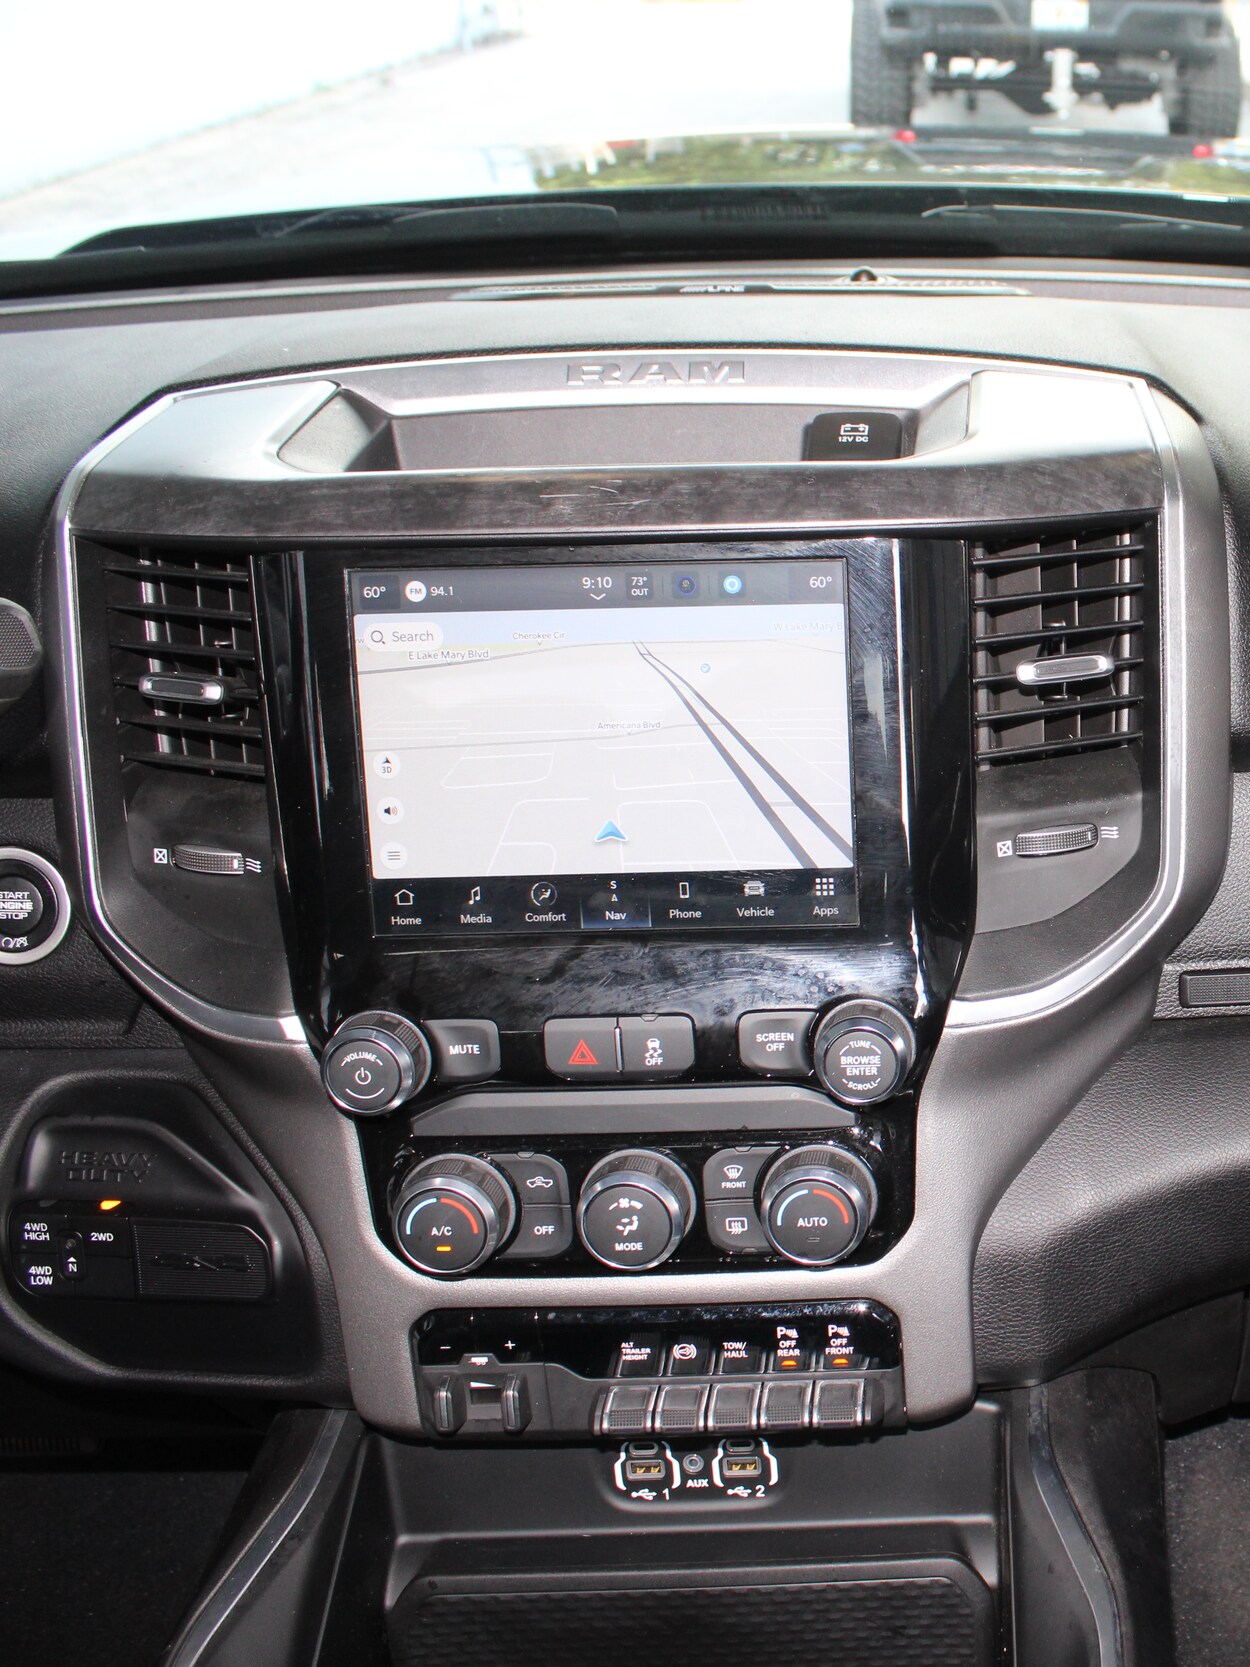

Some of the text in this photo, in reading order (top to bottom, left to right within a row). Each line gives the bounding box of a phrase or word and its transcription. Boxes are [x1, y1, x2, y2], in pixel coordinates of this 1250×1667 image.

[566, 360, 746, 386] RAM
[582, 576, 612, 589] 9:10
[809, 576, 832, 588] 60°
[363, 586, 386, 598] 60°
[410, 586, 454, 597] FM 94.1
[631, 588, 648, 596] OUT
[392, 630, 434, 643] Search
[512, 632, 551, 640] Cherokee
[408, 649, 490, 662] E Lake Mary Blvd
[598, 720, 660, 730] Americana Blvd
[381, 766, 392, 774] 3D
[605, 910, 627, 920] Nav
[669, 908, 702, 918] Phone
[736, 906, 775, 917] Vehicle
[812, 906, 839, 917] Apps
[391, 916, 422, 926] Home
[460, 914, 492, 924] Media
[525, 912, 566, 922] Comfort
[756, 1032, 794, 1042] SCREEN
[448, 1044, 480, 1056] MUTE
[766, 1043, 785, 1052] OFF
[848, 1040, 872, 1050] TUNE
[344, 1051, 378, 1062] VOLUME
[645, 1056, 664, 1066] OFF
[840, 1055, 881, 1065] BROWSE
[846, 1066, 878, 1076] ENTER
[847, 1080, 878, 1091] SCROLL
[58, 1150, 155, 1167] HEAVY
[65, 1168, 150, 1184] DUTY
[721, 1180, 746, 1190] FRONT
[24, 1222, 48, 1232] 4WD
[797, 1217, 828, 1228] AUTO
[431, 1226, 452, 1237] A/C
[534, 1226, 555, 1235] OFF
[24, 1232, 50, 1241] HIGH
[90, 1232, 114, 1242] 2WD
[614, 1242, 643, 1252] MODE
[28, 1266, 52, 1275] 4WD
[68, 1264, 78, 1272] N
[30, 1276, 54, 1286] LOW
[722, 1342, 747, 1350] TOW/
[779, 1340, 797, 1348] OFF
[830, 1338, 848, 1346] OFF
[724, 1350, 748, 1358] HAUL
[777, 1348, 800, 1357] REAR
[825, 1346, 855, 1355] FRONT
[686, 1478, 709, 1488] AUX
[662, 1488, 670, 1501] 1
[755, 1484, 766, 1498] 2
